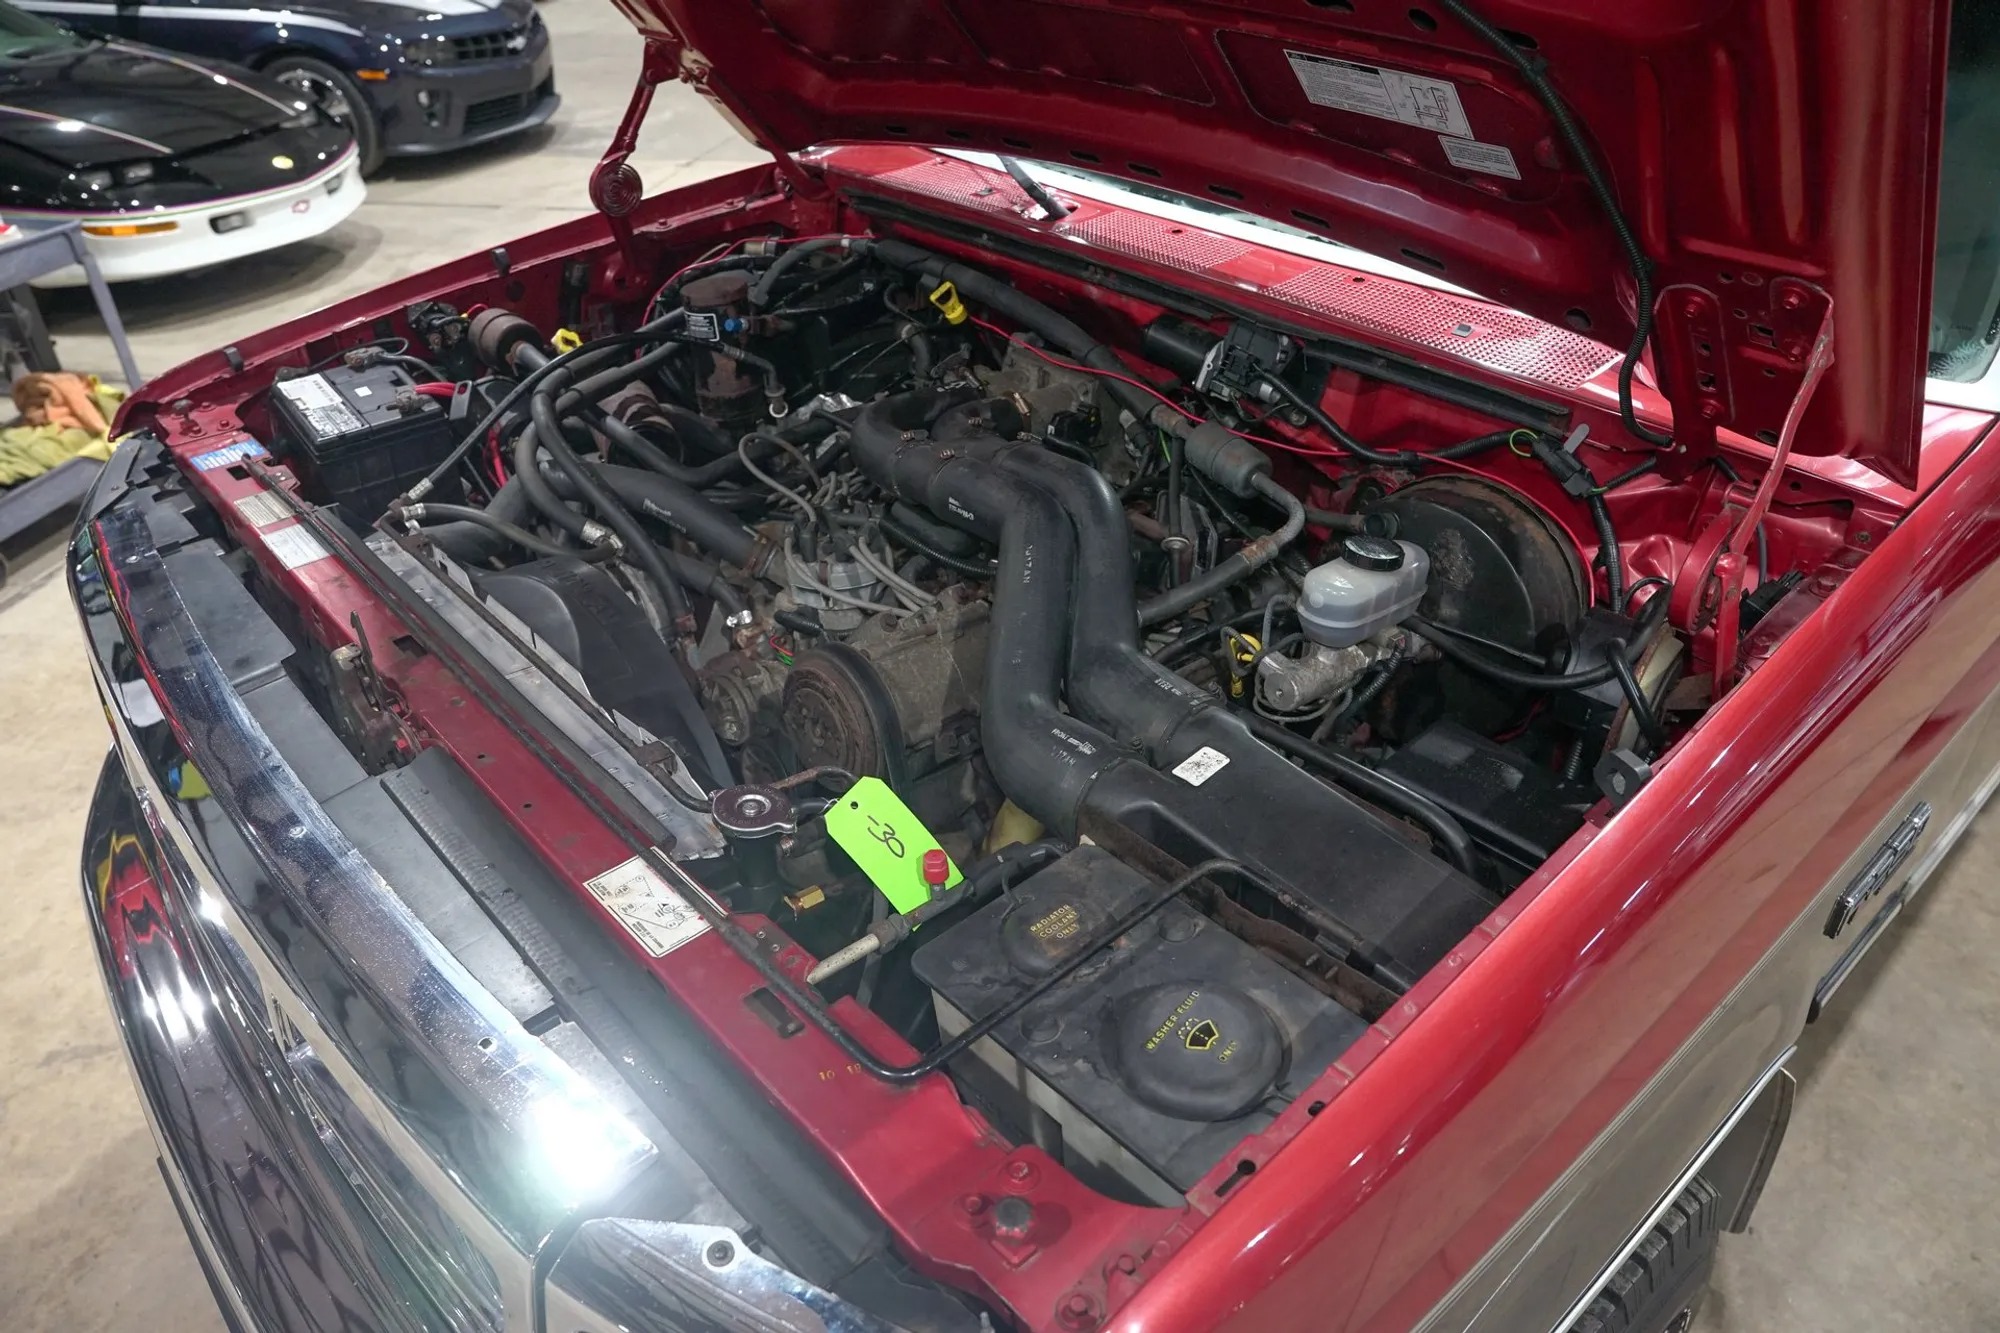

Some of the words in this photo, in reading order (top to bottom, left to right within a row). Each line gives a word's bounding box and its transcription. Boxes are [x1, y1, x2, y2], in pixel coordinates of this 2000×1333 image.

[1030, 904, 1071, 932] RADIATOR
[1040, 911, 1077, 938] COOLANT
[1056, 923, 1078, 938] ONLY
[1146, 1015, 1178, 1050] WASHER
[1178, 990, 1200, 1014] FLUID
[1219, 1040, 1238, 1062] ONLY
